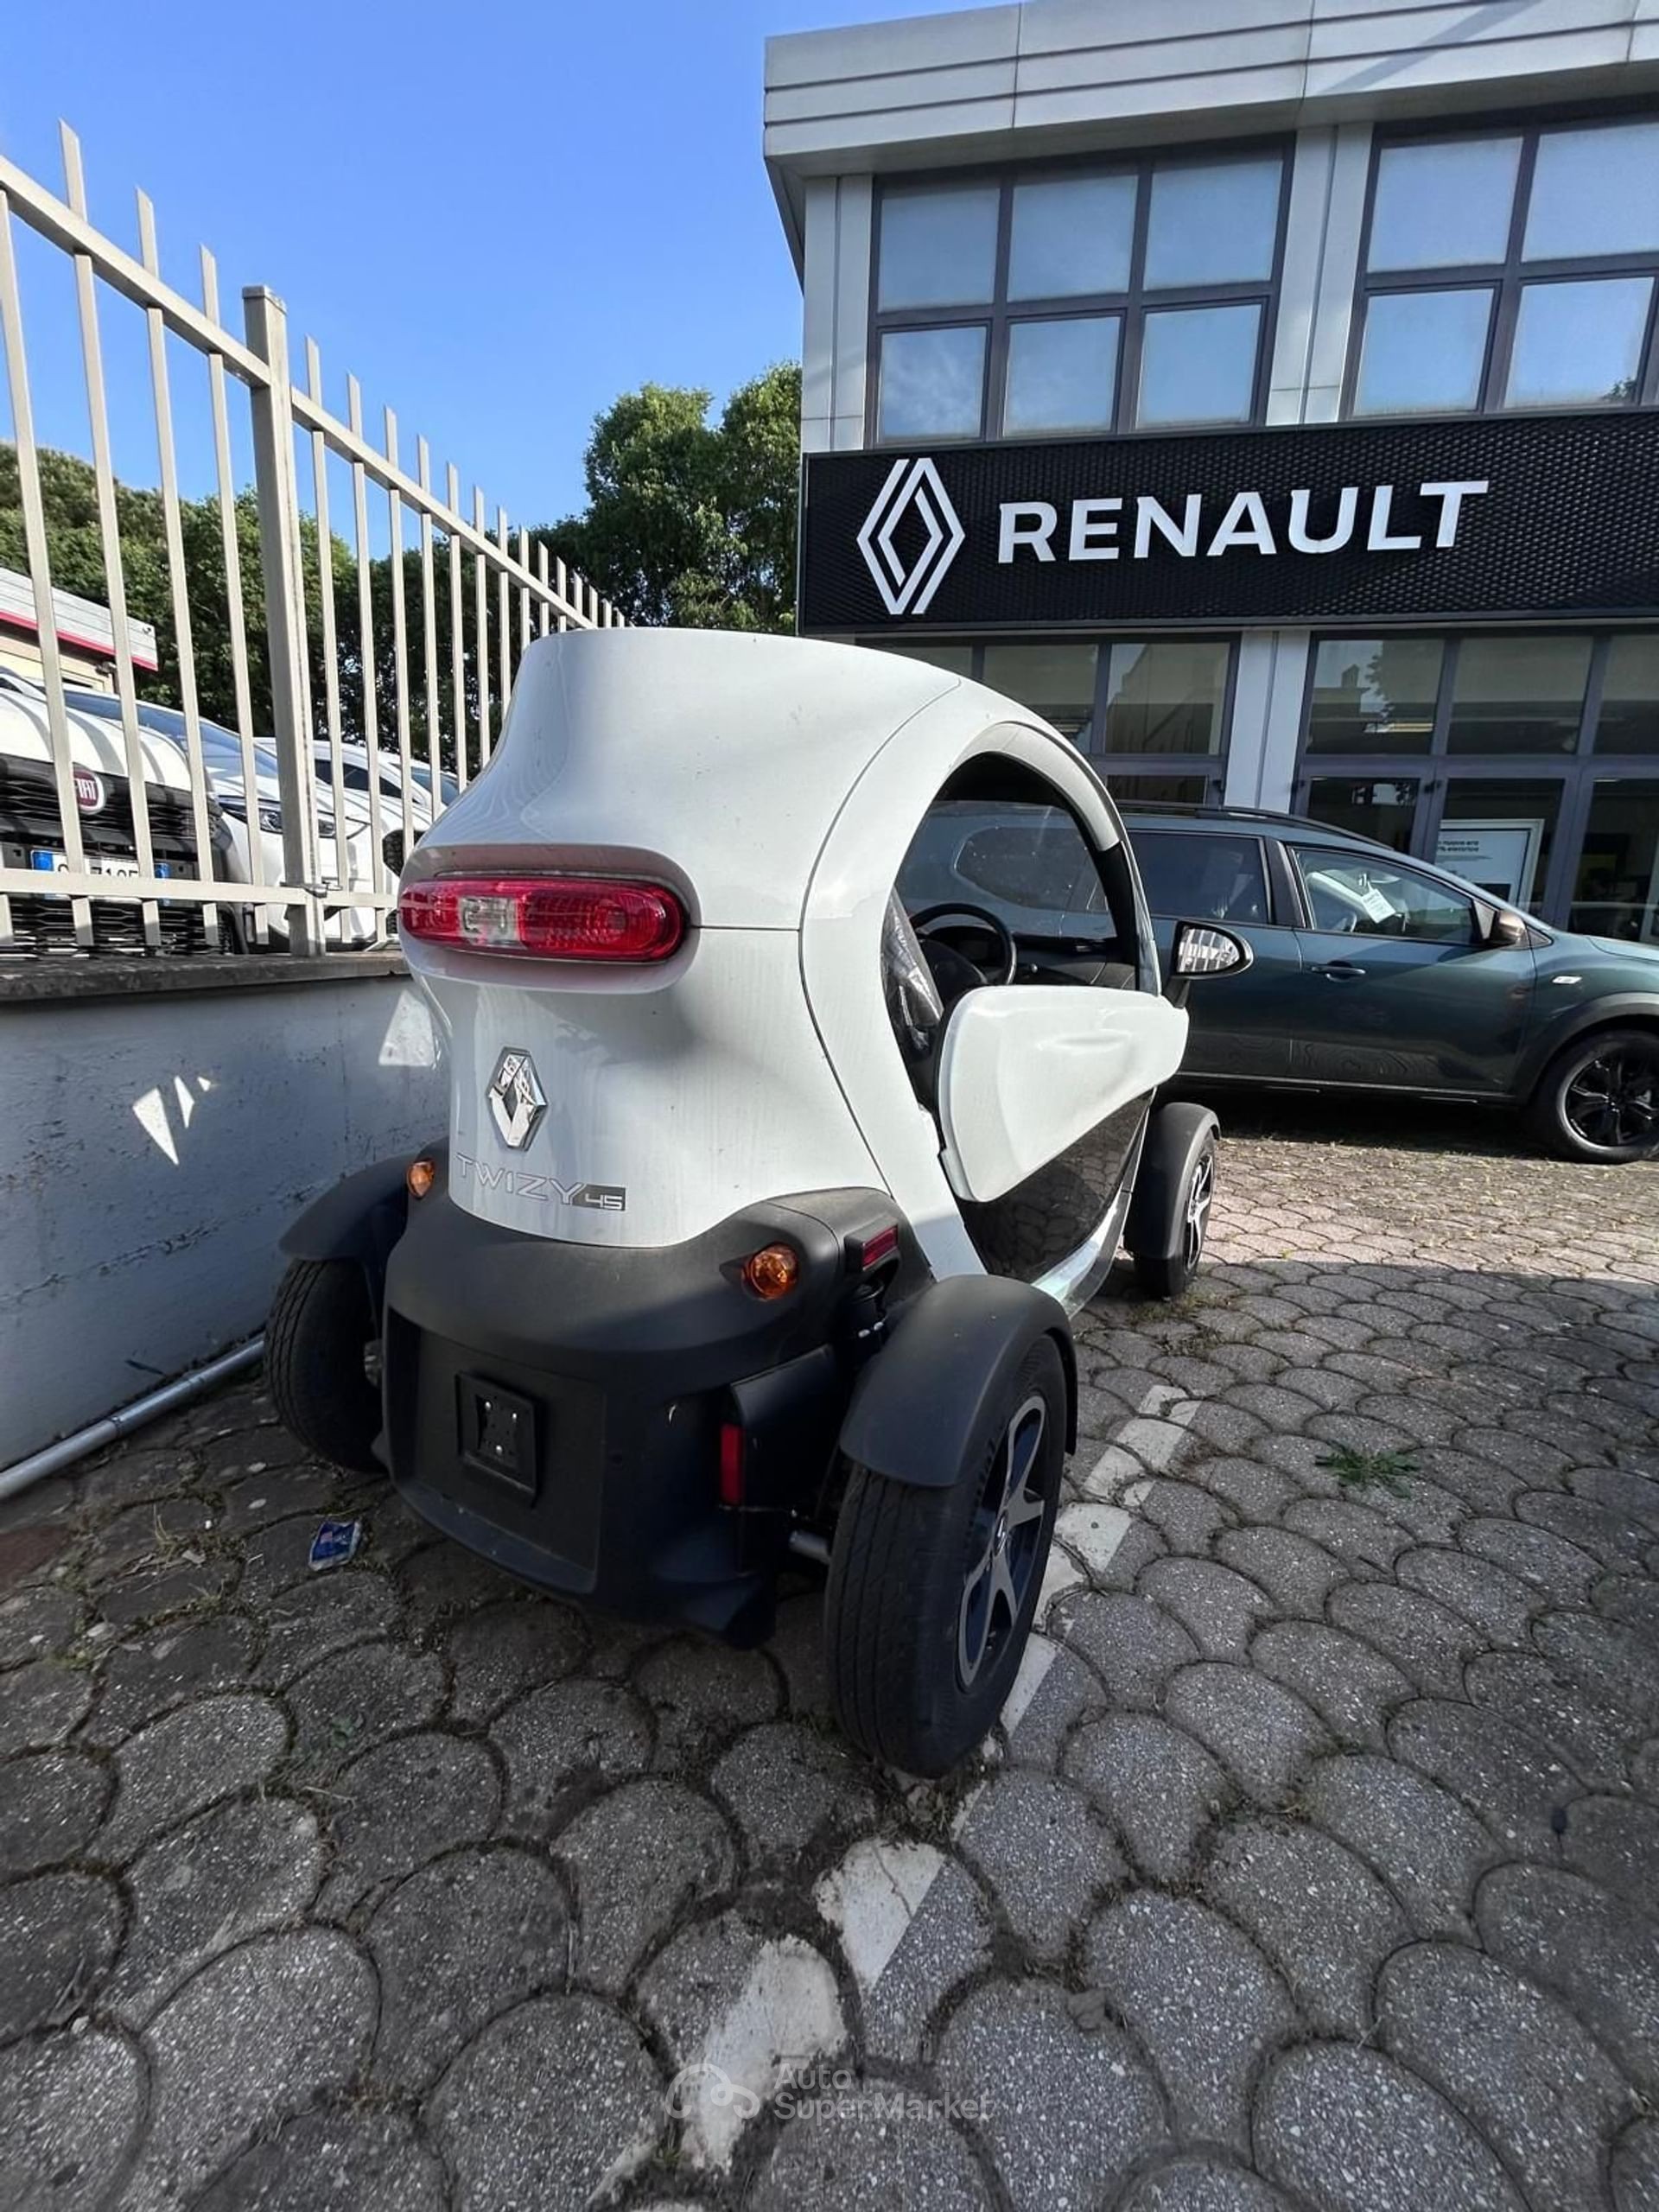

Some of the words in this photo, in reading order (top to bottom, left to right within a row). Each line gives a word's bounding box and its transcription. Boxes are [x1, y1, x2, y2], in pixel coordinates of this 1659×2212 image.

[997, 480, 1490, 564] RENAULT
[74, 778, 97, 800] IAT
[456, 1153, 583, 1206] TWIZY
[584, 1192, 624, 1210] 45
